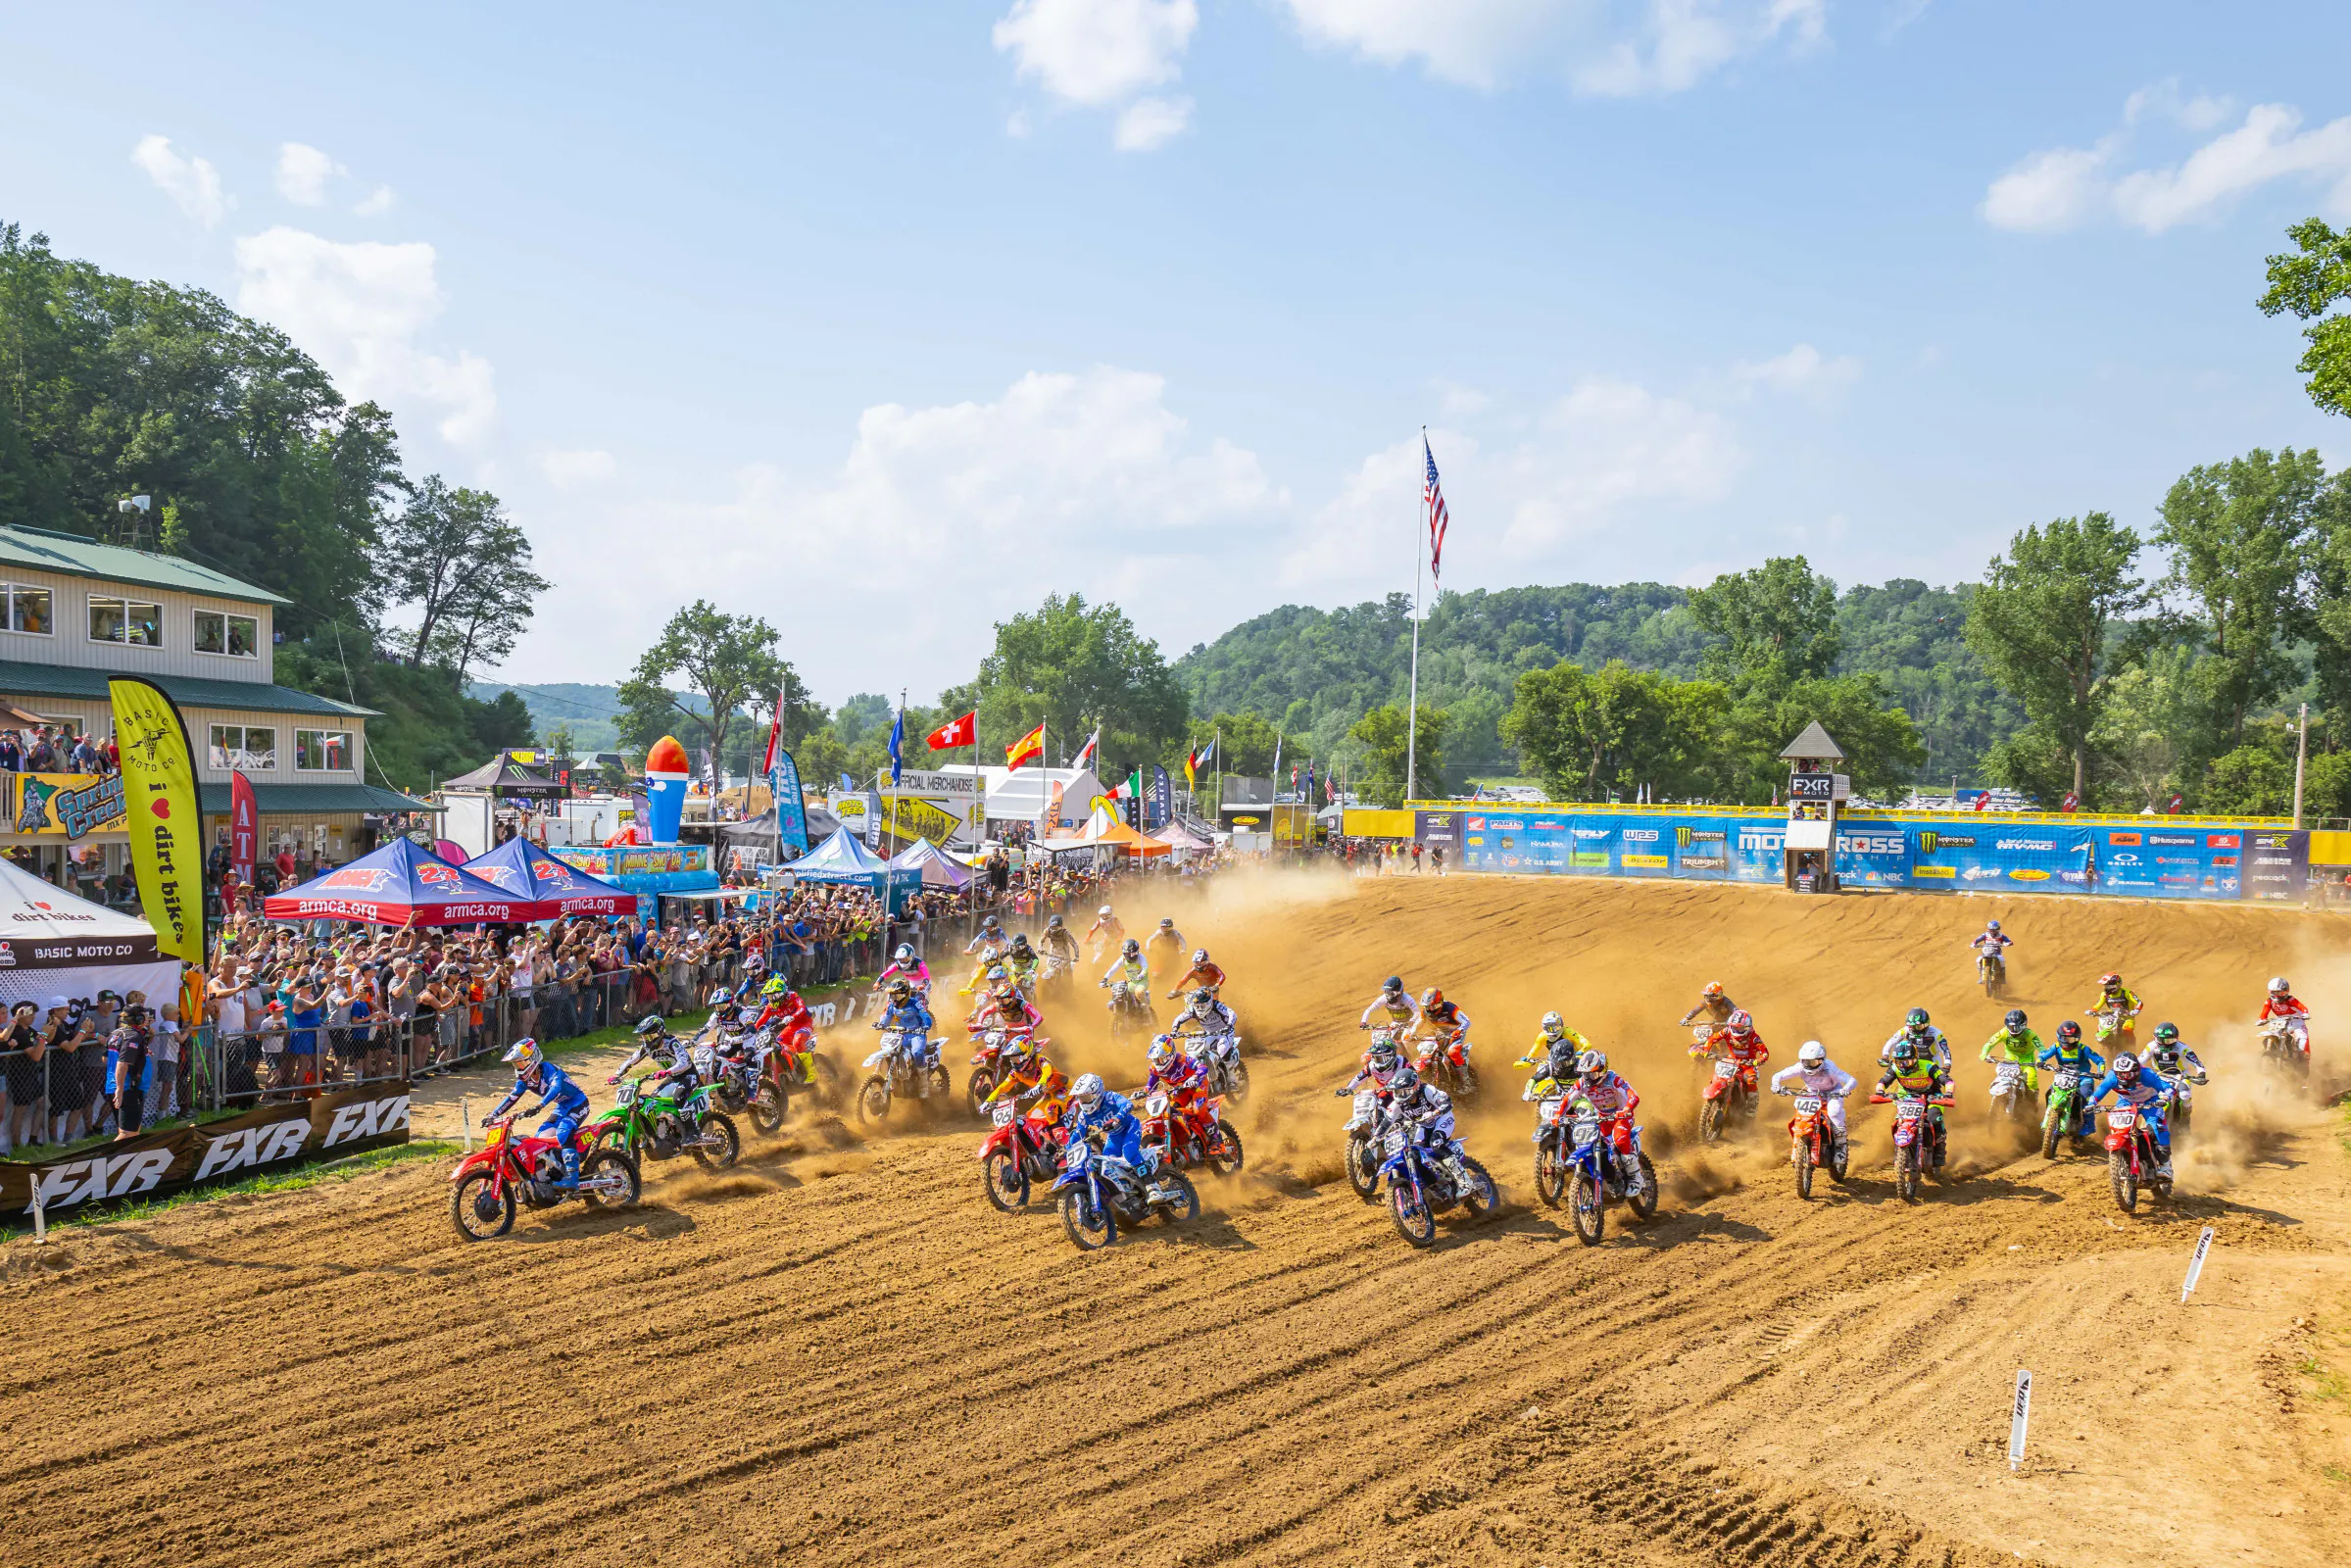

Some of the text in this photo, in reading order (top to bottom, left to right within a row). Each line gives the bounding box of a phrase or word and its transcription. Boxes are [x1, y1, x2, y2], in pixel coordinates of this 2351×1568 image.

[123, 710, 170, 726] BASIC
[127, 756, 157, 772] MOTO
[901, 775, 926, 790] FFICIAL
[927, 776, 973, 792] MERCHANDISE
[1792, 779, 1830, 791] FXR
[837, 800, 863, 811] MOTO
[841, 807, 865, 817] TEES
[1624, 831, 1657, 840] WPS
[155, 825, 176, 875] dirt
[596, 857, 607, 869] DA
[625, 854, 649, 868] MINNE
[671, 852, 682, 867] DA
[1682, 858, 1718, 868] TRIUMPH
[299, 901, 377, 921] armca.org
[444, 903, 510, 920] armca.org
[560, 898, 614, 912] armca.org
[162, 881, 184, 945] bikes
[34, 945, 133, 958] BASIC MOTO CO
[1186, 1042, 1204, 1053] 27
[695, 1050, 710, 1060] 32
[1999, 1067, 2019, 1078] 233
[617, 1087, 634, 1104] 70
[1151, 1100, 1161, 1114] 1
[1797, 1101, 1820, 1113] 146
[1899, 1106, 1923, 1117] 388
[996, 1111, 1011, 1125] 96
[1063, 1111, 1074, 1125] 96
[580, 1131, 595, 1146] 18
[1386, 1137, 1404, 1154] 992
[194, 1118, 313, 1182] FXR
[1068, 1146, 1084, 1166] 37
[23, 1148, 175, 1215] FXR
[2196, 1239, 2206, 1260] UFO
[2016, 1390, 2025, 1417] UFO
